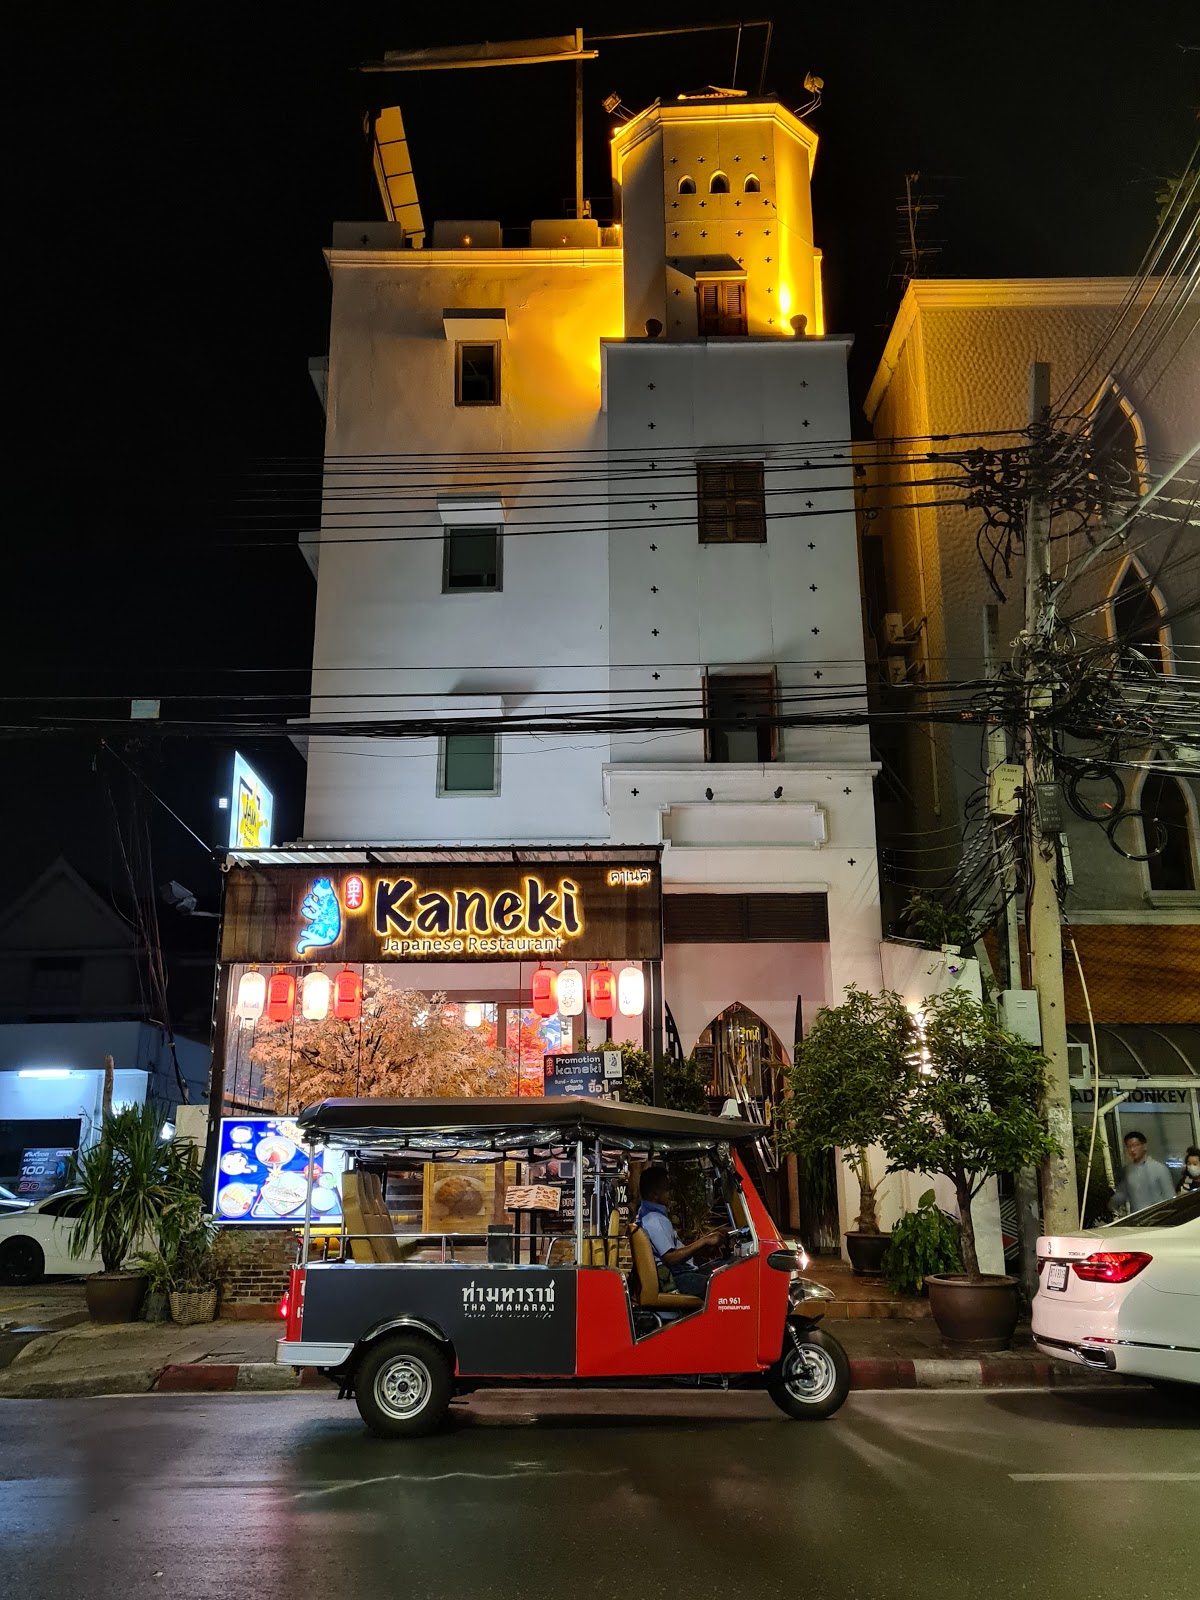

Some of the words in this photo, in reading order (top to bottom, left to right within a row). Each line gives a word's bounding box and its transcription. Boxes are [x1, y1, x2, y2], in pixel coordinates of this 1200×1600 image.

[347, 877, 361, 907] 金木
[375, 878, 580, 934] Kaneki
[383, 937, 462, 956] Japanese
[468, 936, 562, 951] Restaurant
[555, 1055, 600, 1065] Promotion
[555, 1063, 602, 1075] kaneki
[601, 1079, 609, 1093] 1
[21, 1166, 44, 1175] 100
[729, 1296, 741, 1305] 961
[463, 1303, 486, 1312] THA
[495, 1303, 555, 1312] MAHARAJ
